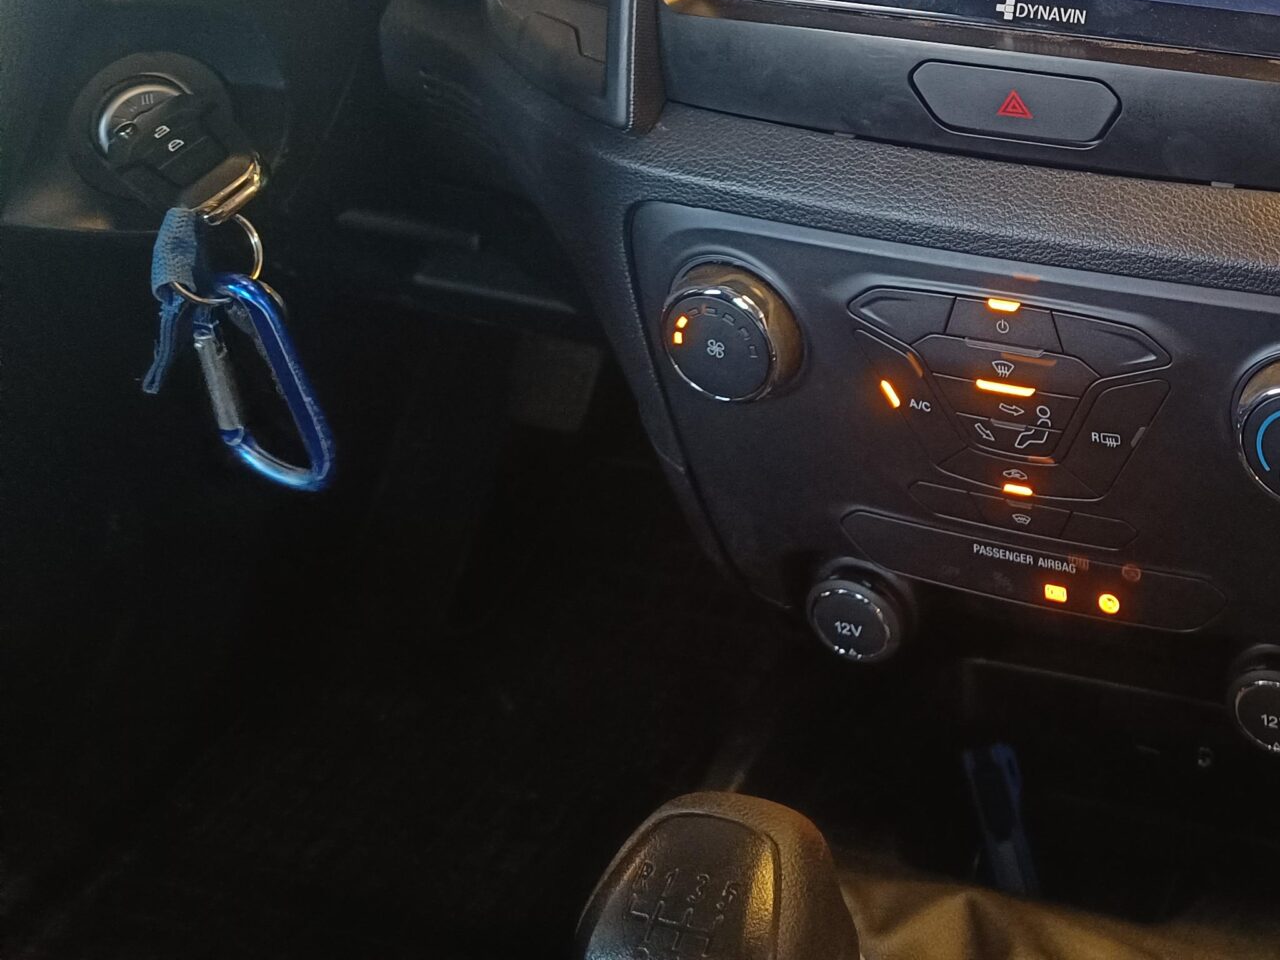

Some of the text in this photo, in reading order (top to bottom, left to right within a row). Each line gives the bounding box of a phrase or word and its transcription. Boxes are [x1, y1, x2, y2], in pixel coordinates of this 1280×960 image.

[1015, 2, 1087, 25] DYNAVIN
[909, 398, 932, 412] A/C
[1091, 432, 1099, 443] R
[973, 543, 1077, 574] PASSENGER AIRBAG
[834, 621, 862, 637] 12V
